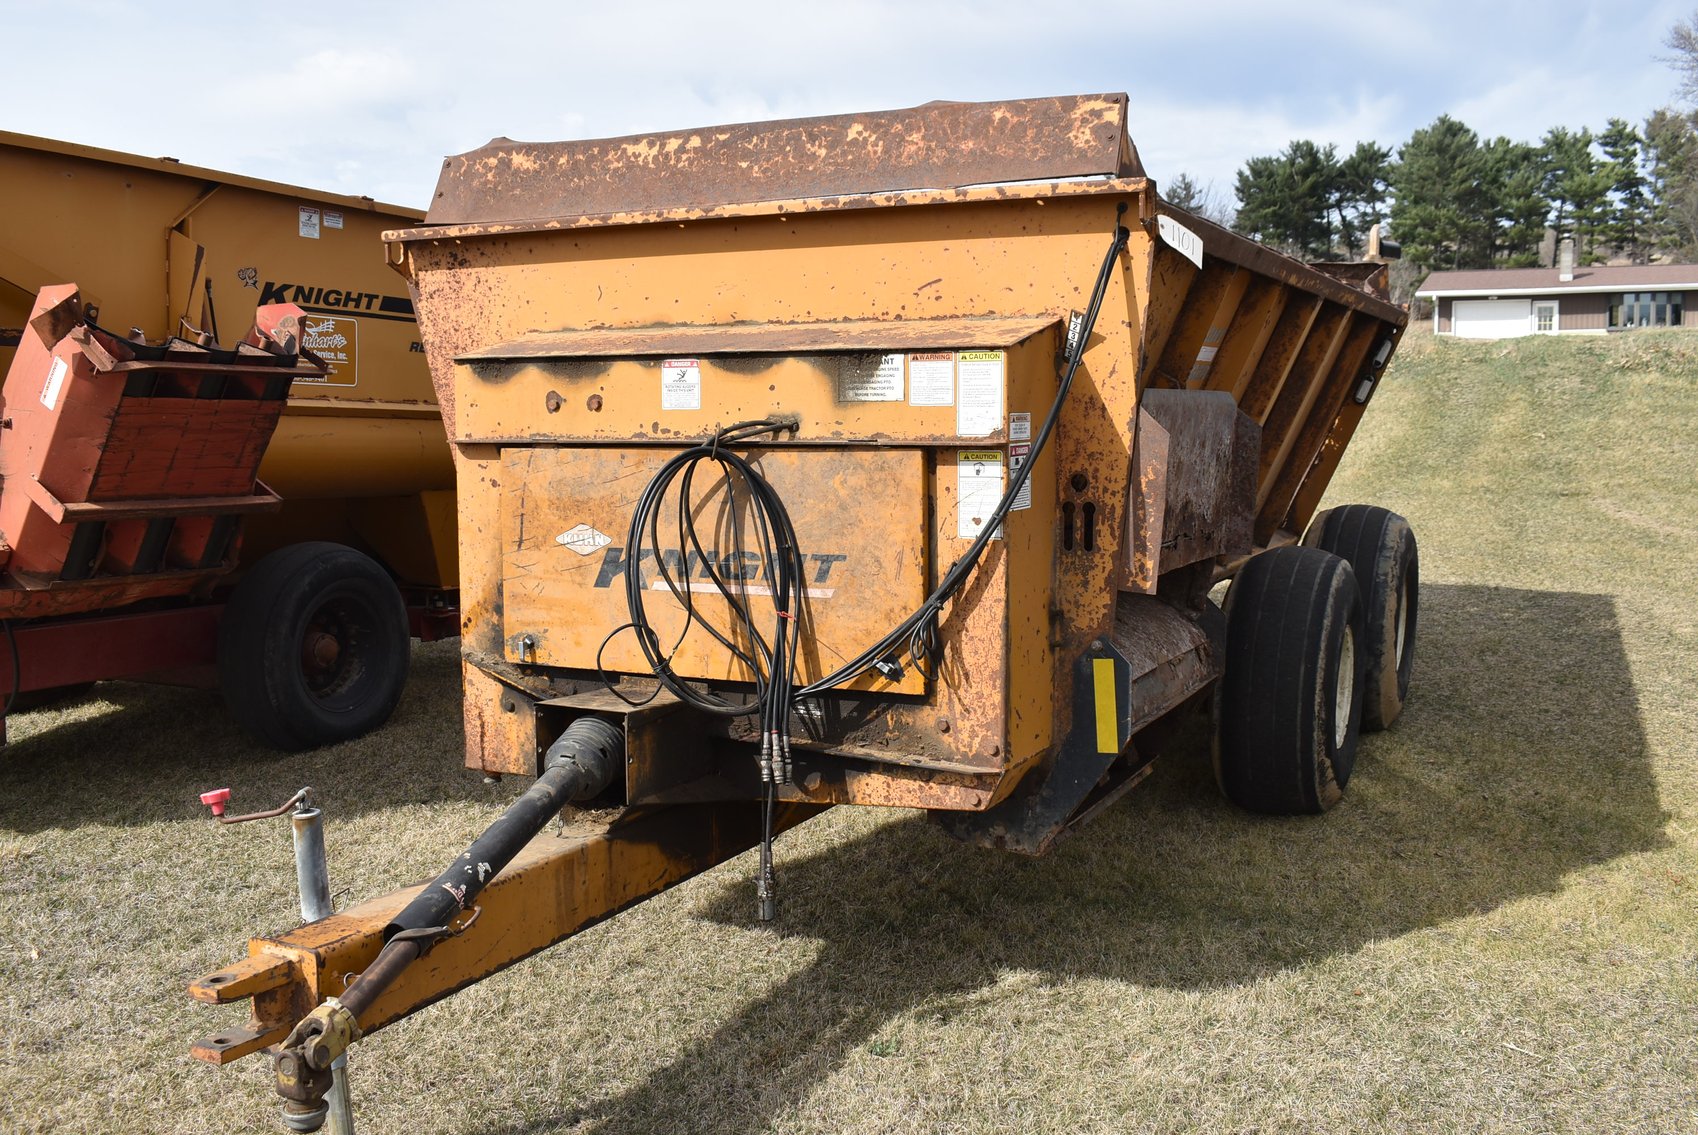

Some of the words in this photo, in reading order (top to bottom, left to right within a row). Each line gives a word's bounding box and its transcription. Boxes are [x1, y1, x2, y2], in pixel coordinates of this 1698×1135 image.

[1172, 224, 1195, 256] 1101
[257, 281, 380, 310] KNIGHT
[563, 532, 605, 547] KUHN
